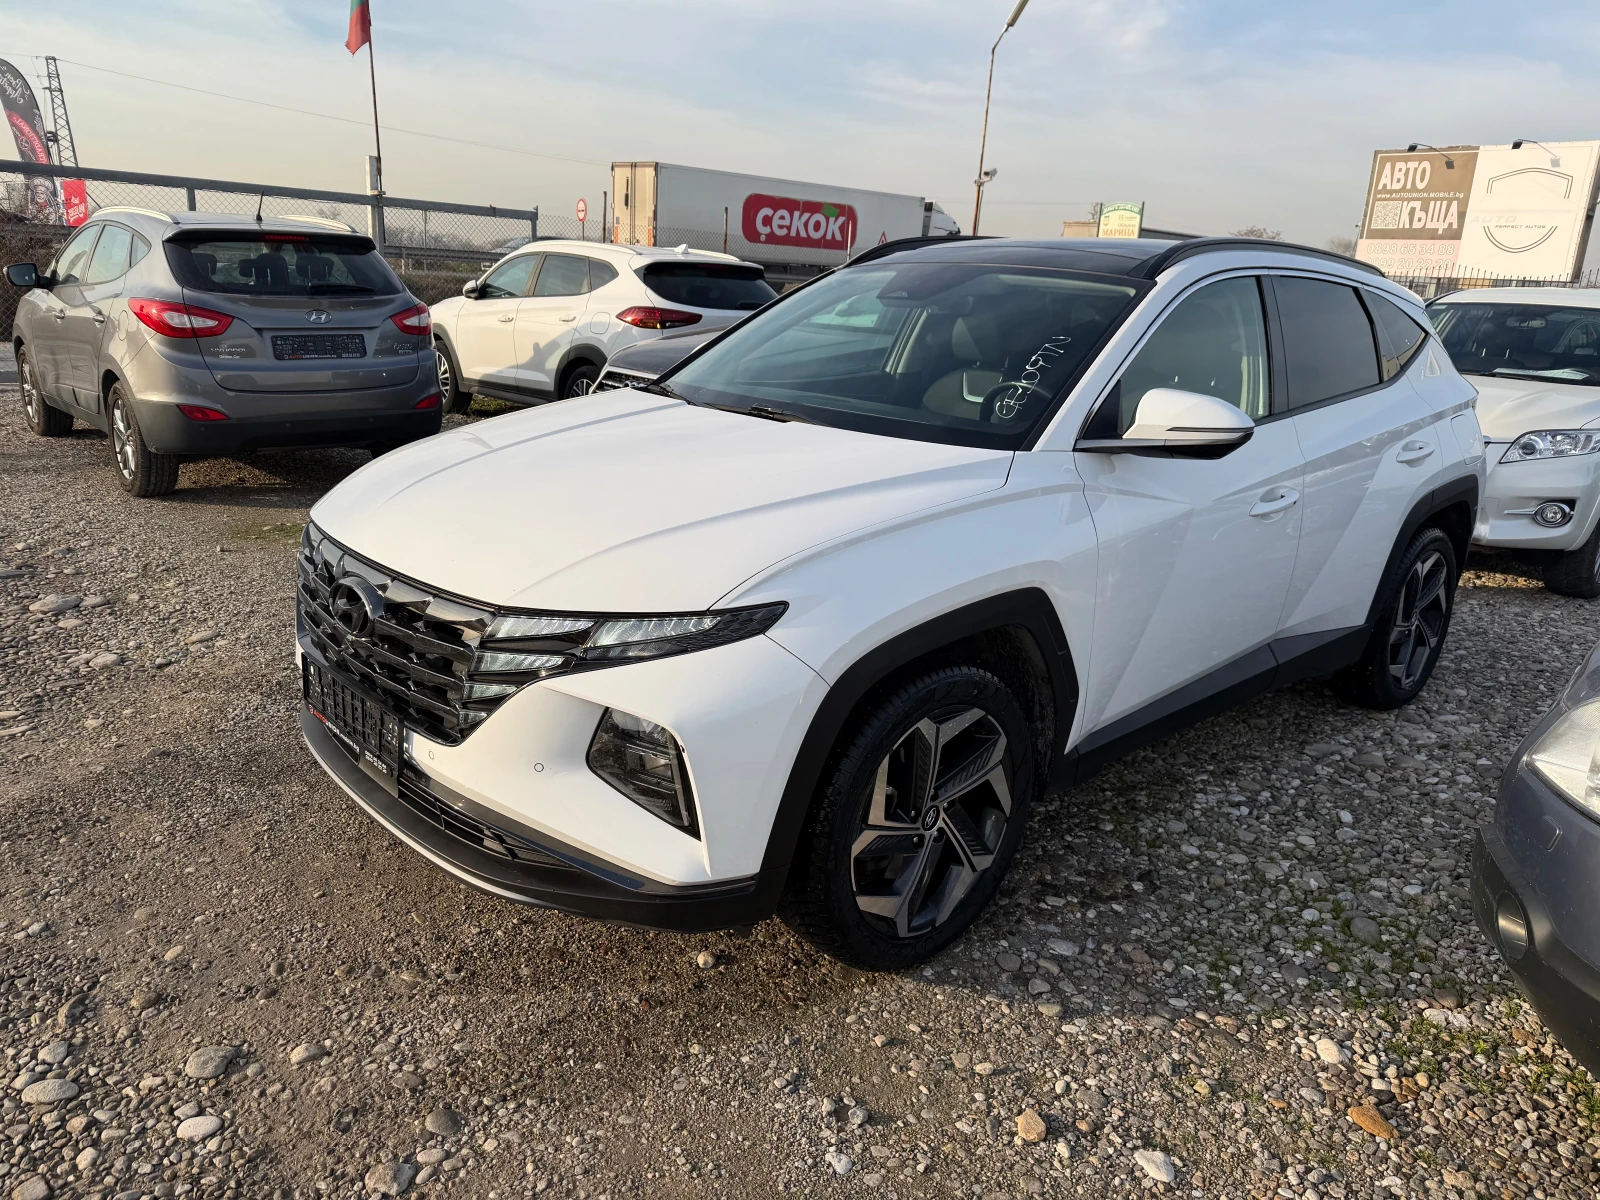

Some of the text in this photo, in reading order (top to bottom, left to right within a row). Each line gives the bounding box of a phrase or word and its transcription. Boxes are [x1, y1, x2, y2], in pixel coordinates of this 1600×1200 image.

[1378, 160, 1431, 190] АВТО
[1398, 200, 1458, 234] КЪЩА
[1102, 229, 1134, 237] МАРИЦА
[1367, 243, 1455, 255] 0898 65 34 88
[1397, 258, 1413, 270] 20
[1416, 258, 1433, 270] 22
[1435, 258, 1452, 270] 20
